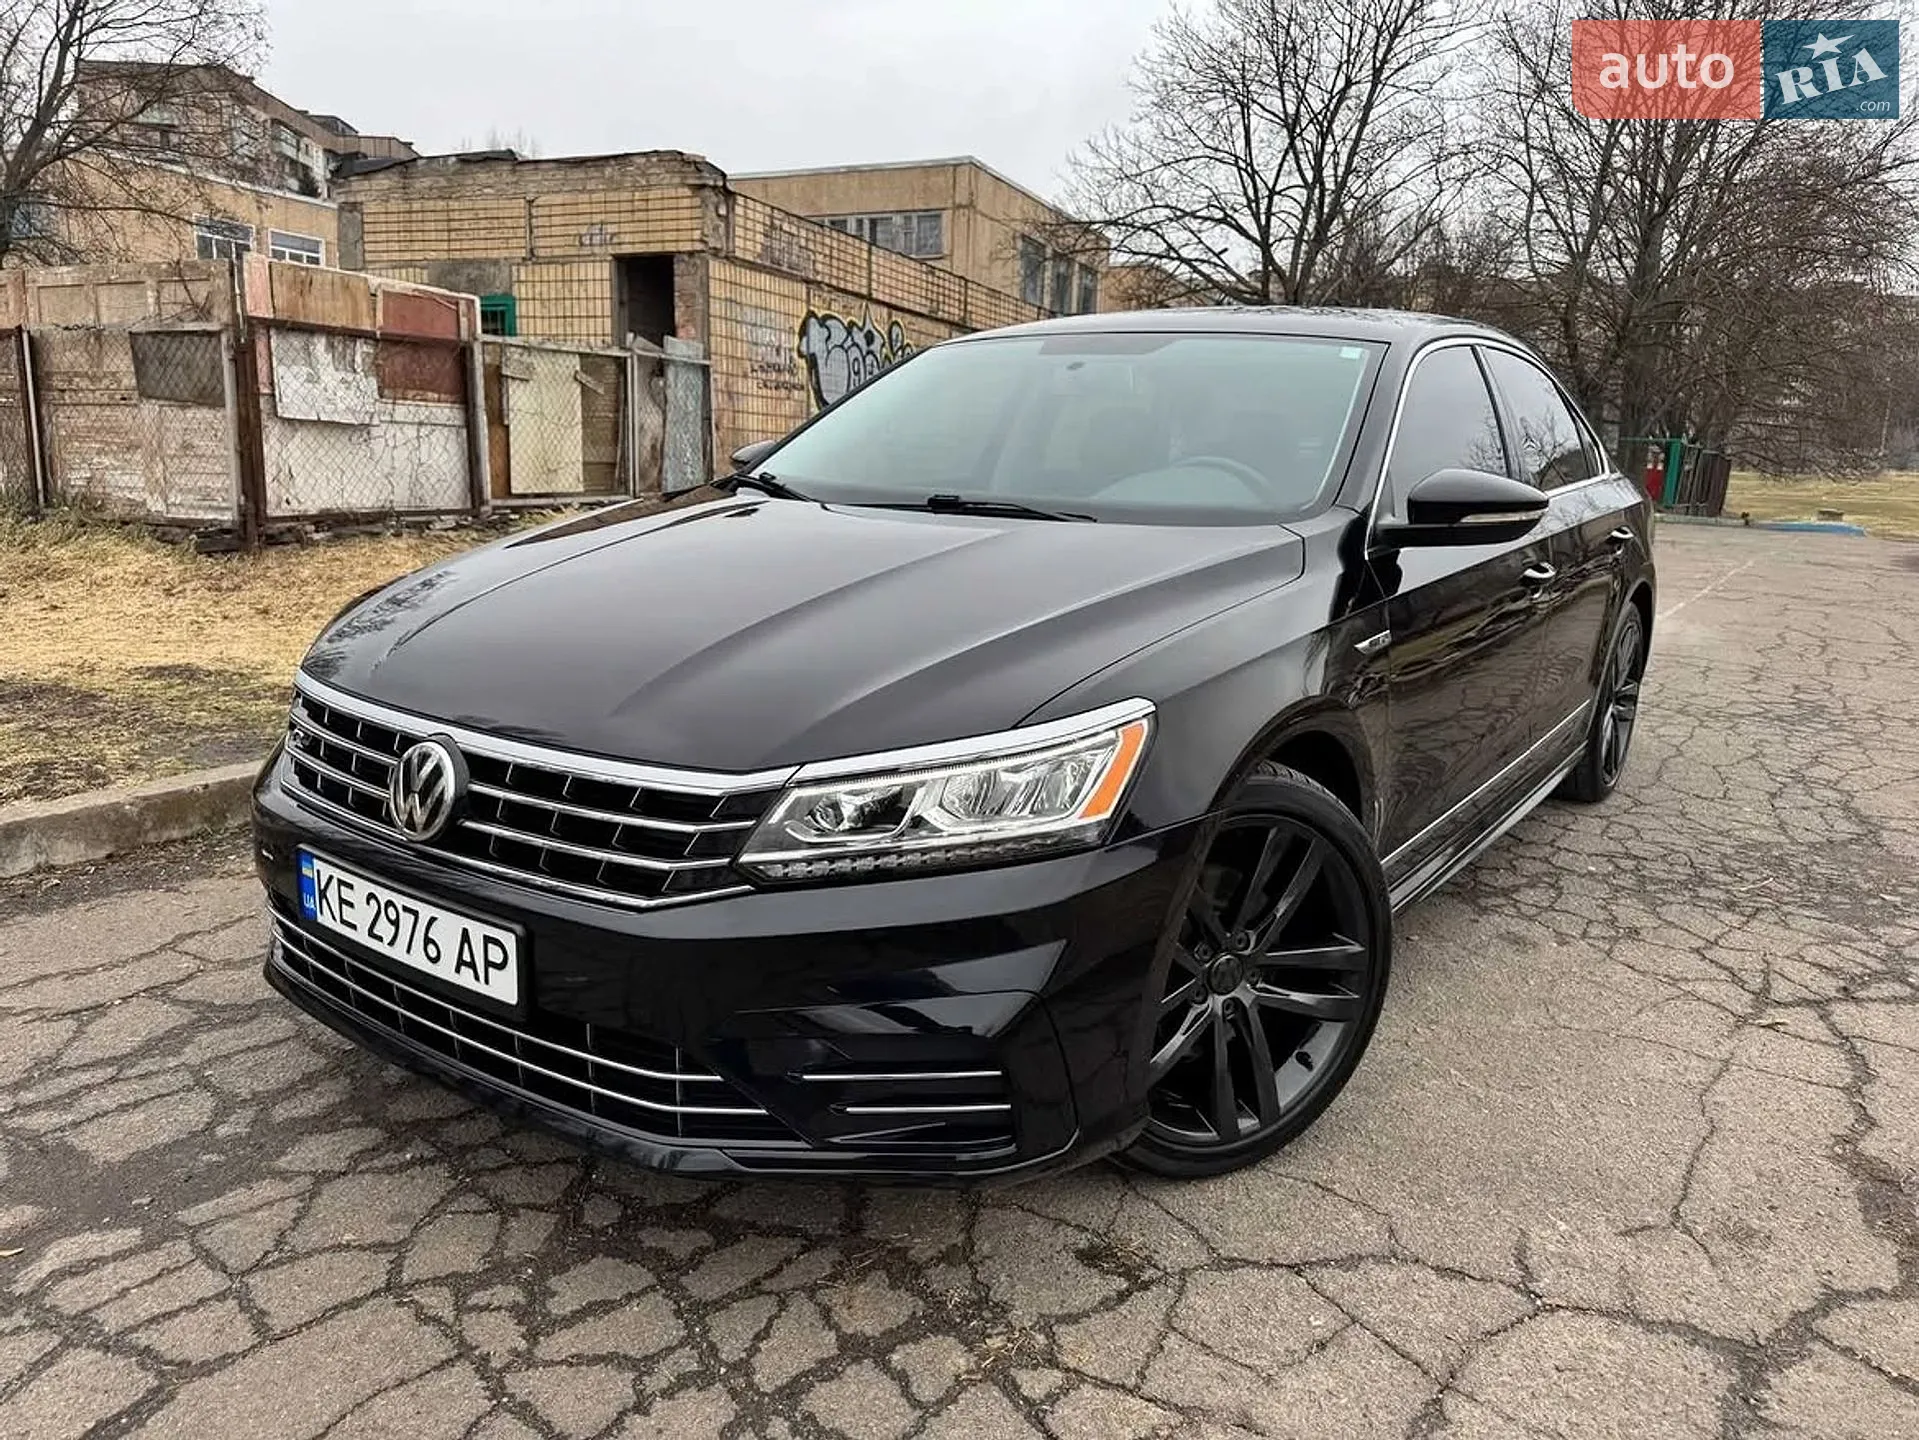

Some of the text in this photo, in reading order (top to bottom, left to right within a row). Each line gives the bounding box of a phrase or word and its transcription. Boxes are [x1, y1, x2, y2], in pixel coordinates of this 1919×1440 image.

[316, 868, 509, 986] KE 2976 AP
